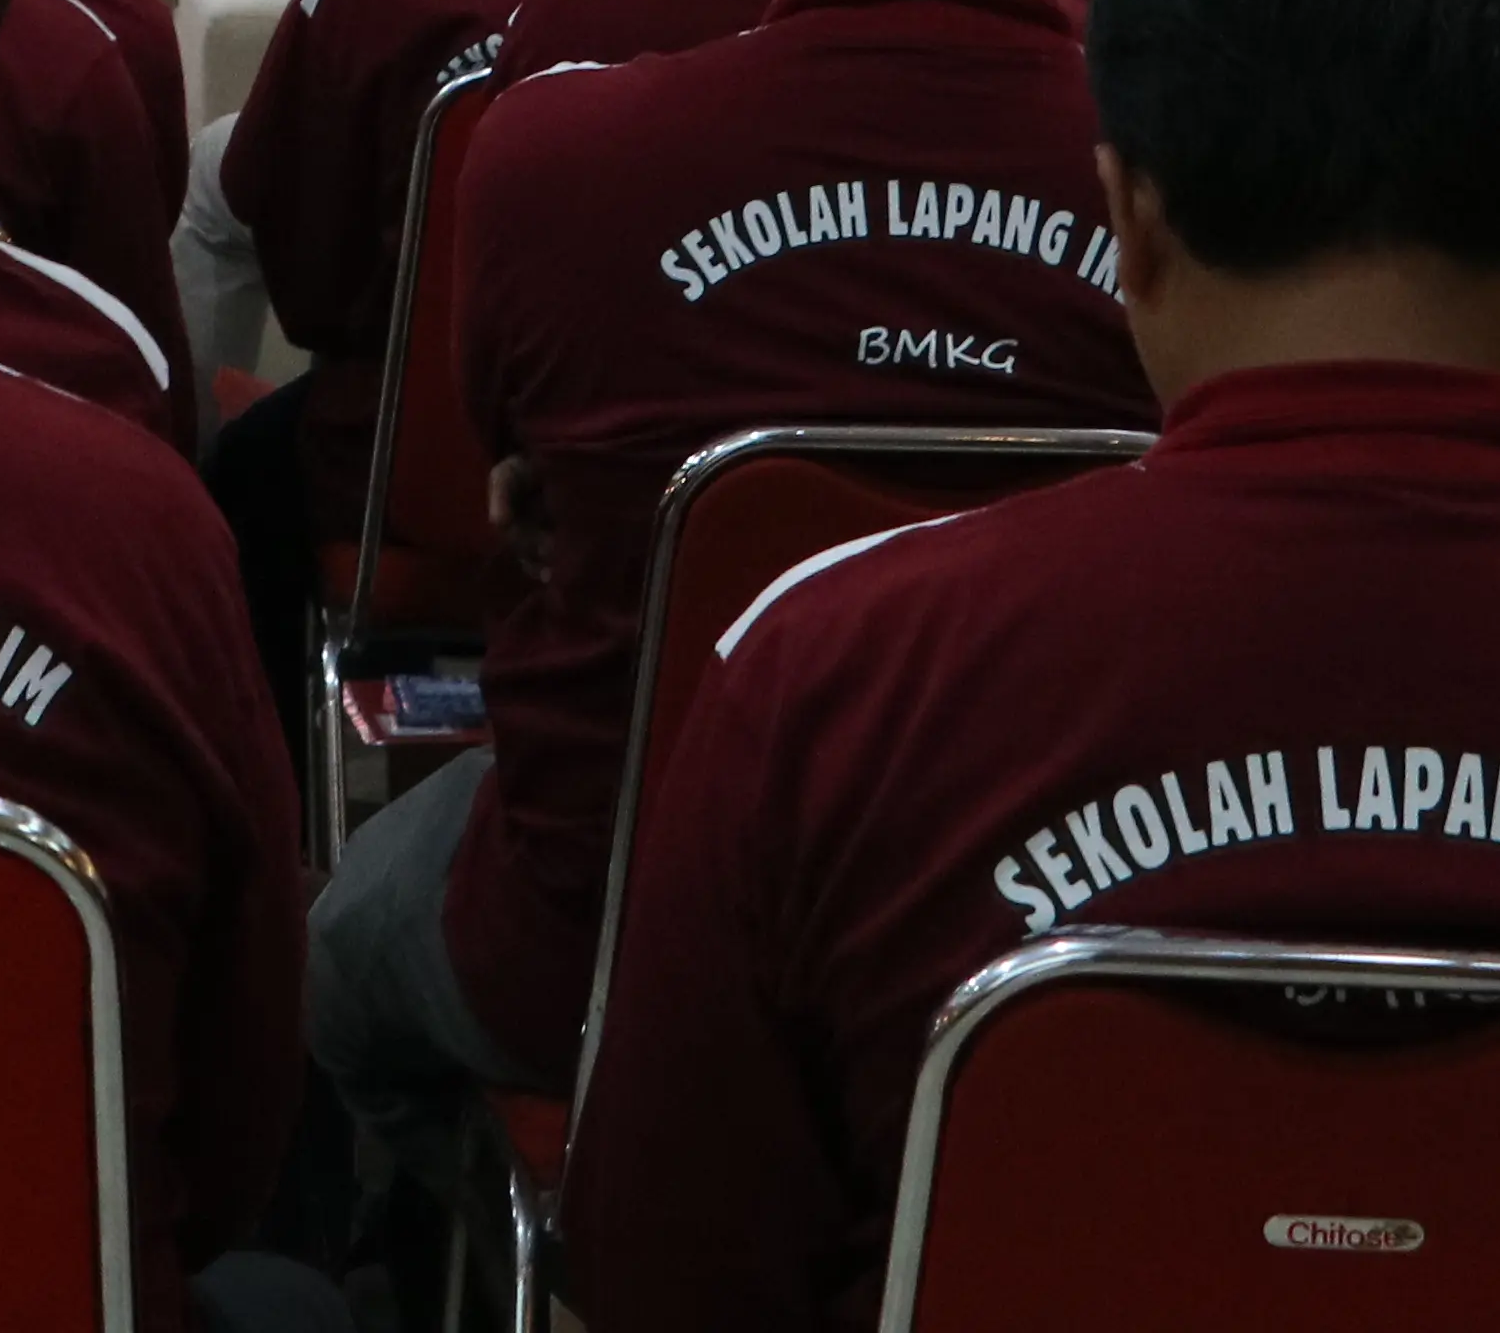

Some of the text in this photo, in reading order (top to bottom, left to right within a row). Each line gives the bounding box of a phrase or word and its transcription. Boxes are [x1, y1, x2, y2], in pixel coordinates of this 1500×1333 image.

[660, 179, 1075, 302] SEKOLAH LAPANG
[858, 326, 1018, 374] BMKG
[994, 750, 1294, 935] SEKOLAH
[1287, 1222, 1397, 1249] Chitose
